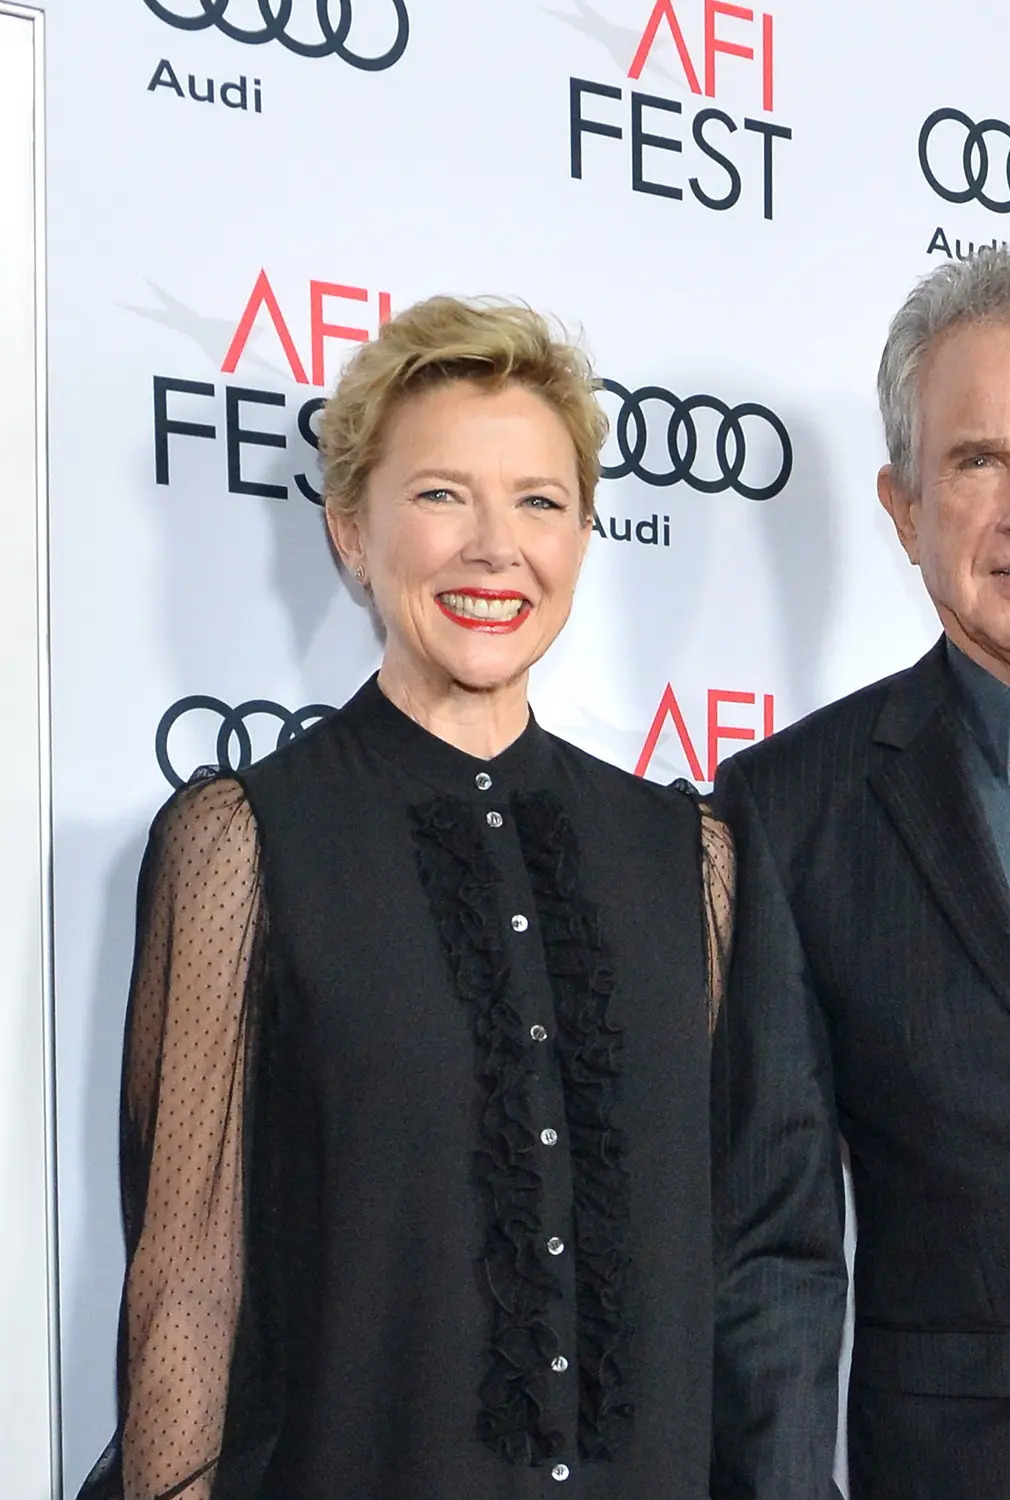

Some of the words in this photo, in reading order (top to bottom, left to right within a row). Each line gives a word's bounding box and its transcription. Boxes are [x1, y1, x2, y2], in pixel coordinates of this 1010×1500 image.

[148, 59, 263, 113] Audi
[627, 0, 773, 112] AFI
[570, 76, 792, 221] FEST
[592, 505, 670, 547] Audi
